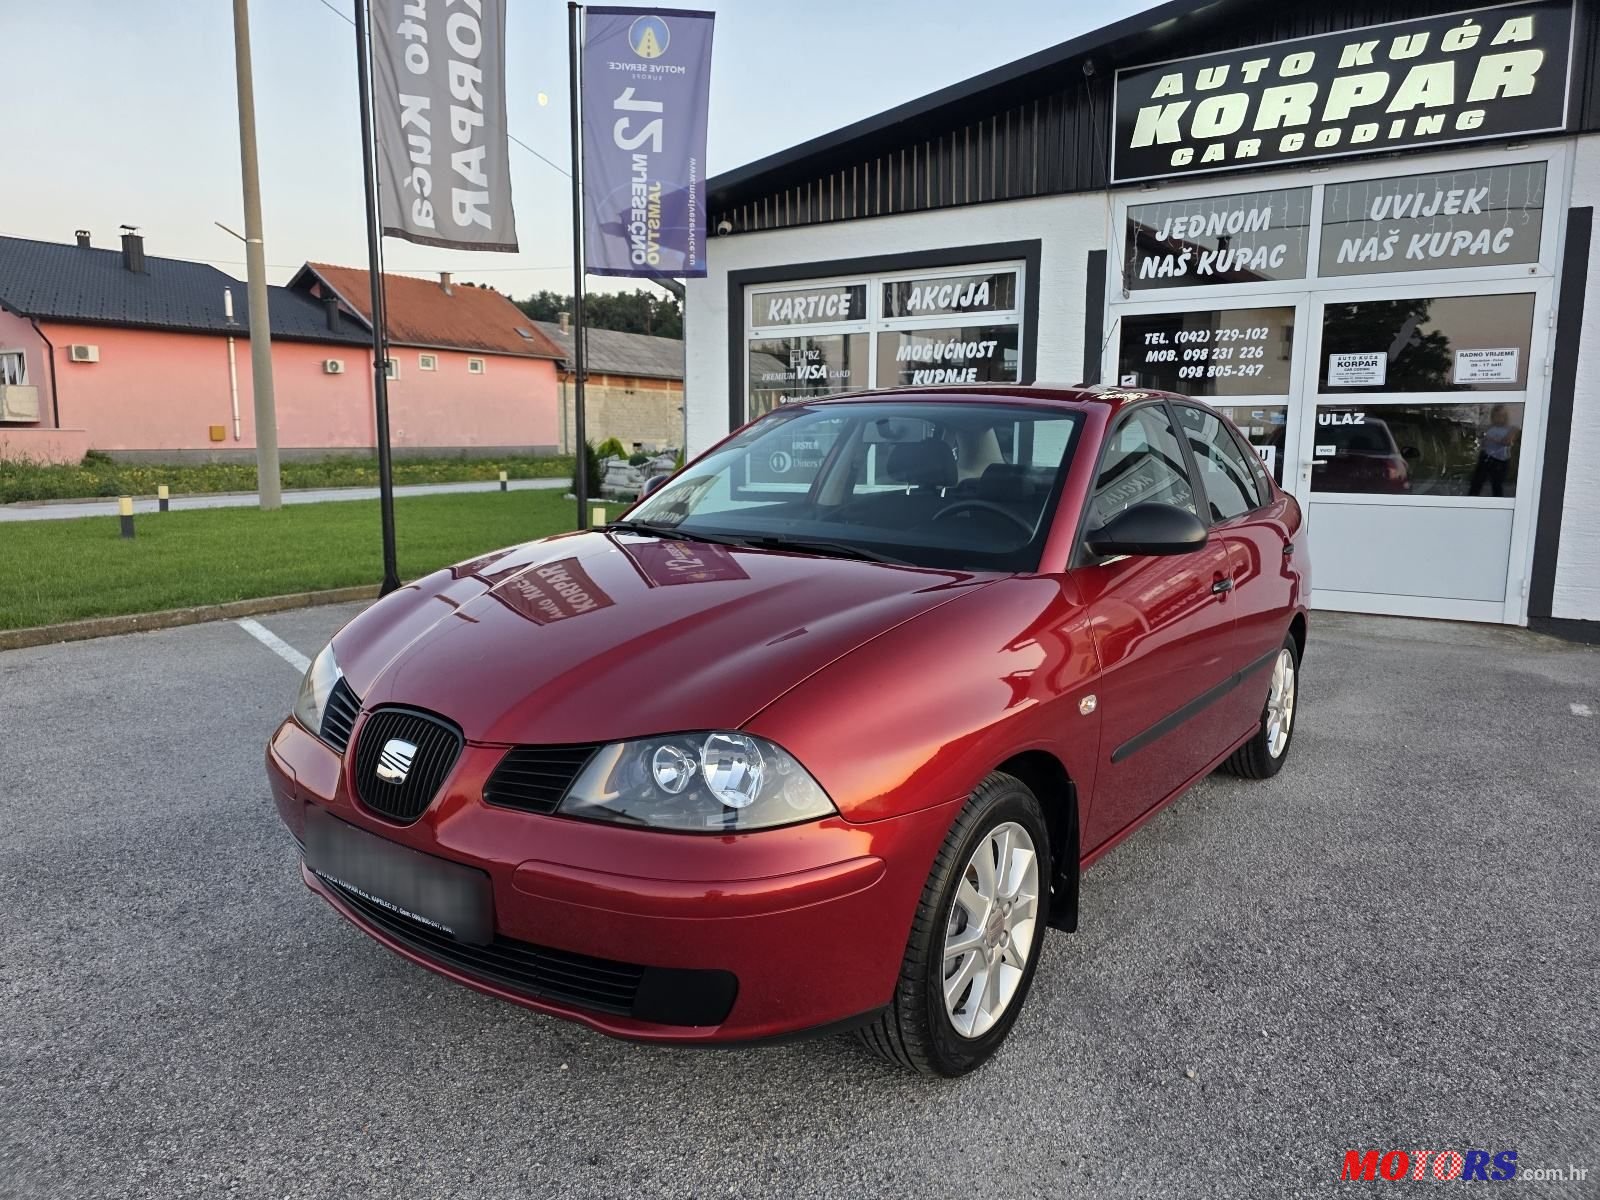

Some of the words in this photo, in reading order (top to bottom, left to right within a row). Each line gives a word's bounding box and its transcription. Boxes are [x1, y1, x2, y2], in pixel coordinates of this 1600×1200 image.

[1150, 51, 1315, 99] AUTO
[1338, 16, 1534, 69] KUĆA
[1130, 48, 1544, 149] KORPAR
[1170, 138, 1262, 167] CAR
[1279, 109, 1486, 154] CODING
[1370, 186, 1489, 222] UVIJEK
[1155, 206, 1272, 243] JEDNOM
[1336, 229, 1402, 265] NAŠ
[1405, 227, 1514, 261] KUPAC
[1139, 248, 1190, 280] NAŠ
[1197, 244, 1287, 276] KUPAC
[767, 293, 852, 322] KARTICE
[906, 281, 990, 311] AKCIJA
[895, 338, 998, 362] MOGUĆNOST
[1144, 332, 1169, 345] TEL.
[1174, 329, 1211, 344] (042)
[1214, 327, 1269, 342] 729-102
[802, 350, 821, 361] PBZ
[1145, 349, 1179, 363] MOB.
[1183, 348, 1209, 361] 098
[1211, 347, 1234, 360] 231
[1239, 346, 1264, 359] 226
[1336, 360, 1378, 368] KORPAR
[761, 370, 796, 382] PREMIUM
[795, 364, 828, 380] VISA
[829, 369, 851, 379] CARD
[911, 367, 978, 385] KUPNJE
[1178, 365, 1204, 379] 098
[1206, 364, 1264, 378] 805-247
[1318, 412, 1365, 426] ULAZ
[536, 563, 598, 614] KORPAR
